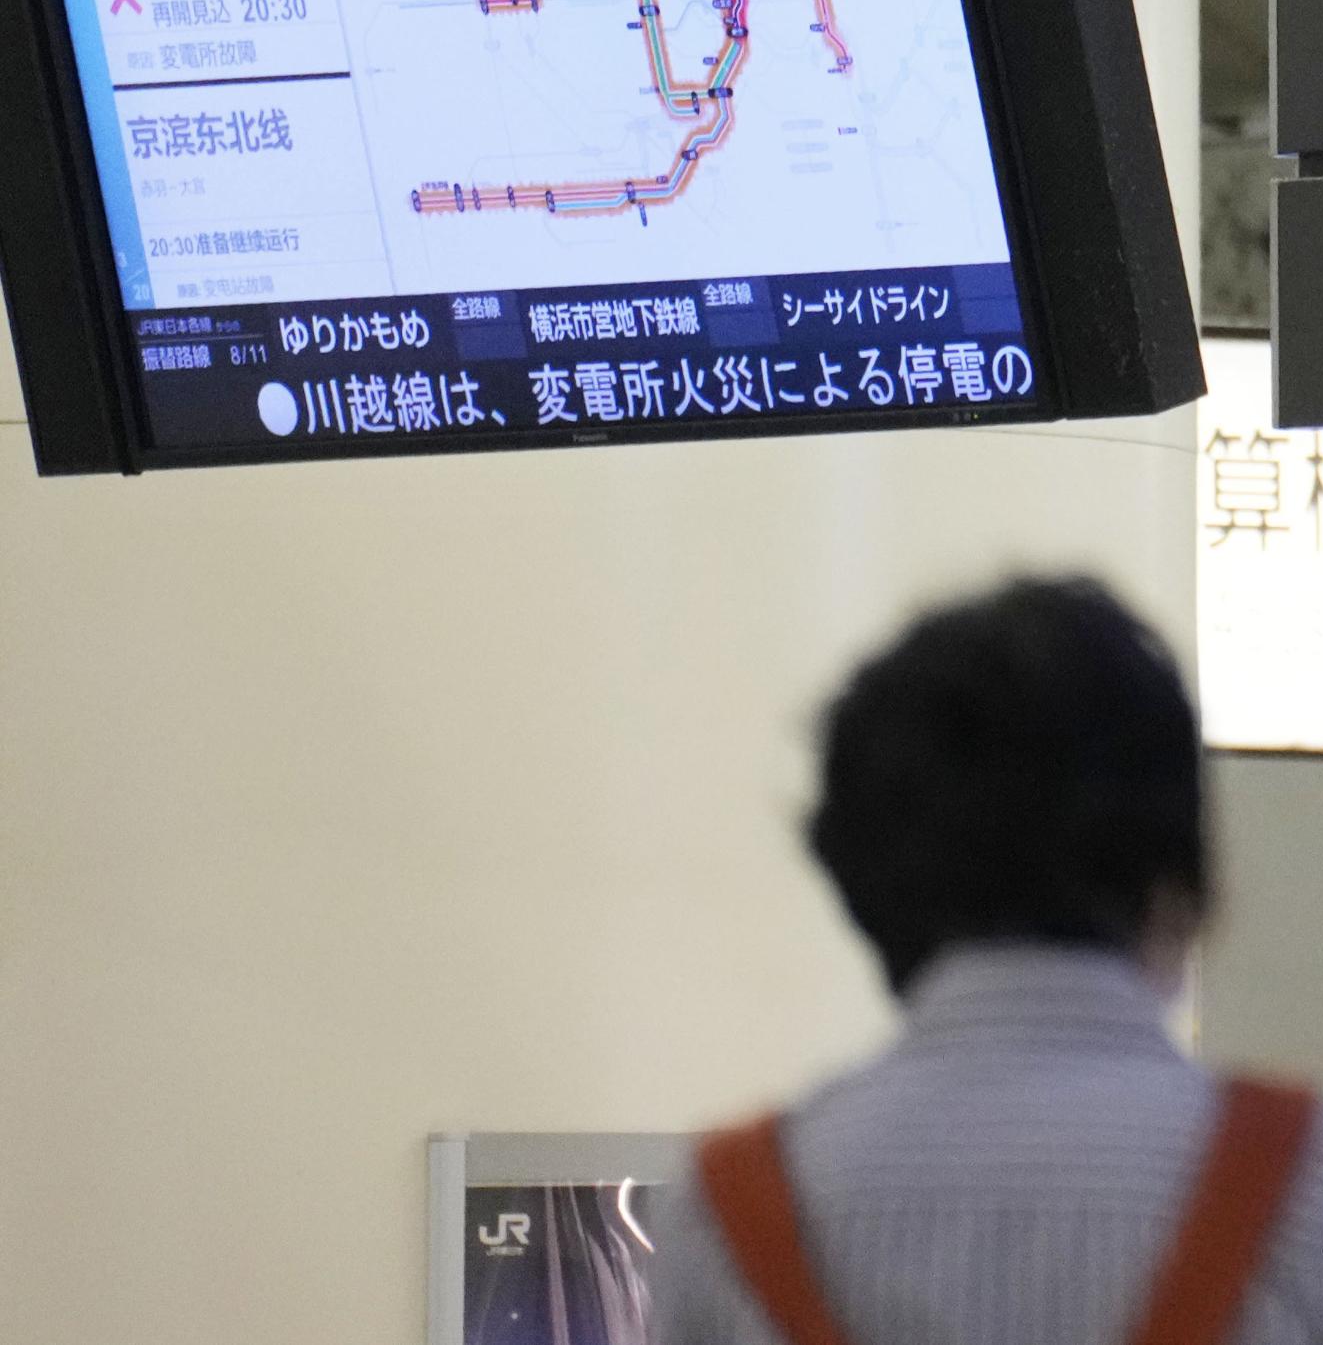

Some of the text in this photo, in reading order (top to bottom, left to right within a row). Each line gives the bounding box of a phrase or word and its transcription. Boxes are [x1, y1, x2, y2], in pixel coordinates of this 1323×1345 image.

[451, 297, 502, 322] 全路線
[703, 283, 754, 308] 全路線
[781, 287, 949, 327] シーサイドライン
[279, 312, 430, 356] ゆりかもめ
[529, 299, 701, 344] 横浜市営地下鉄線
[229, 344, 268, 365] 8/11
[479, 1212, 531, 1246] JR
